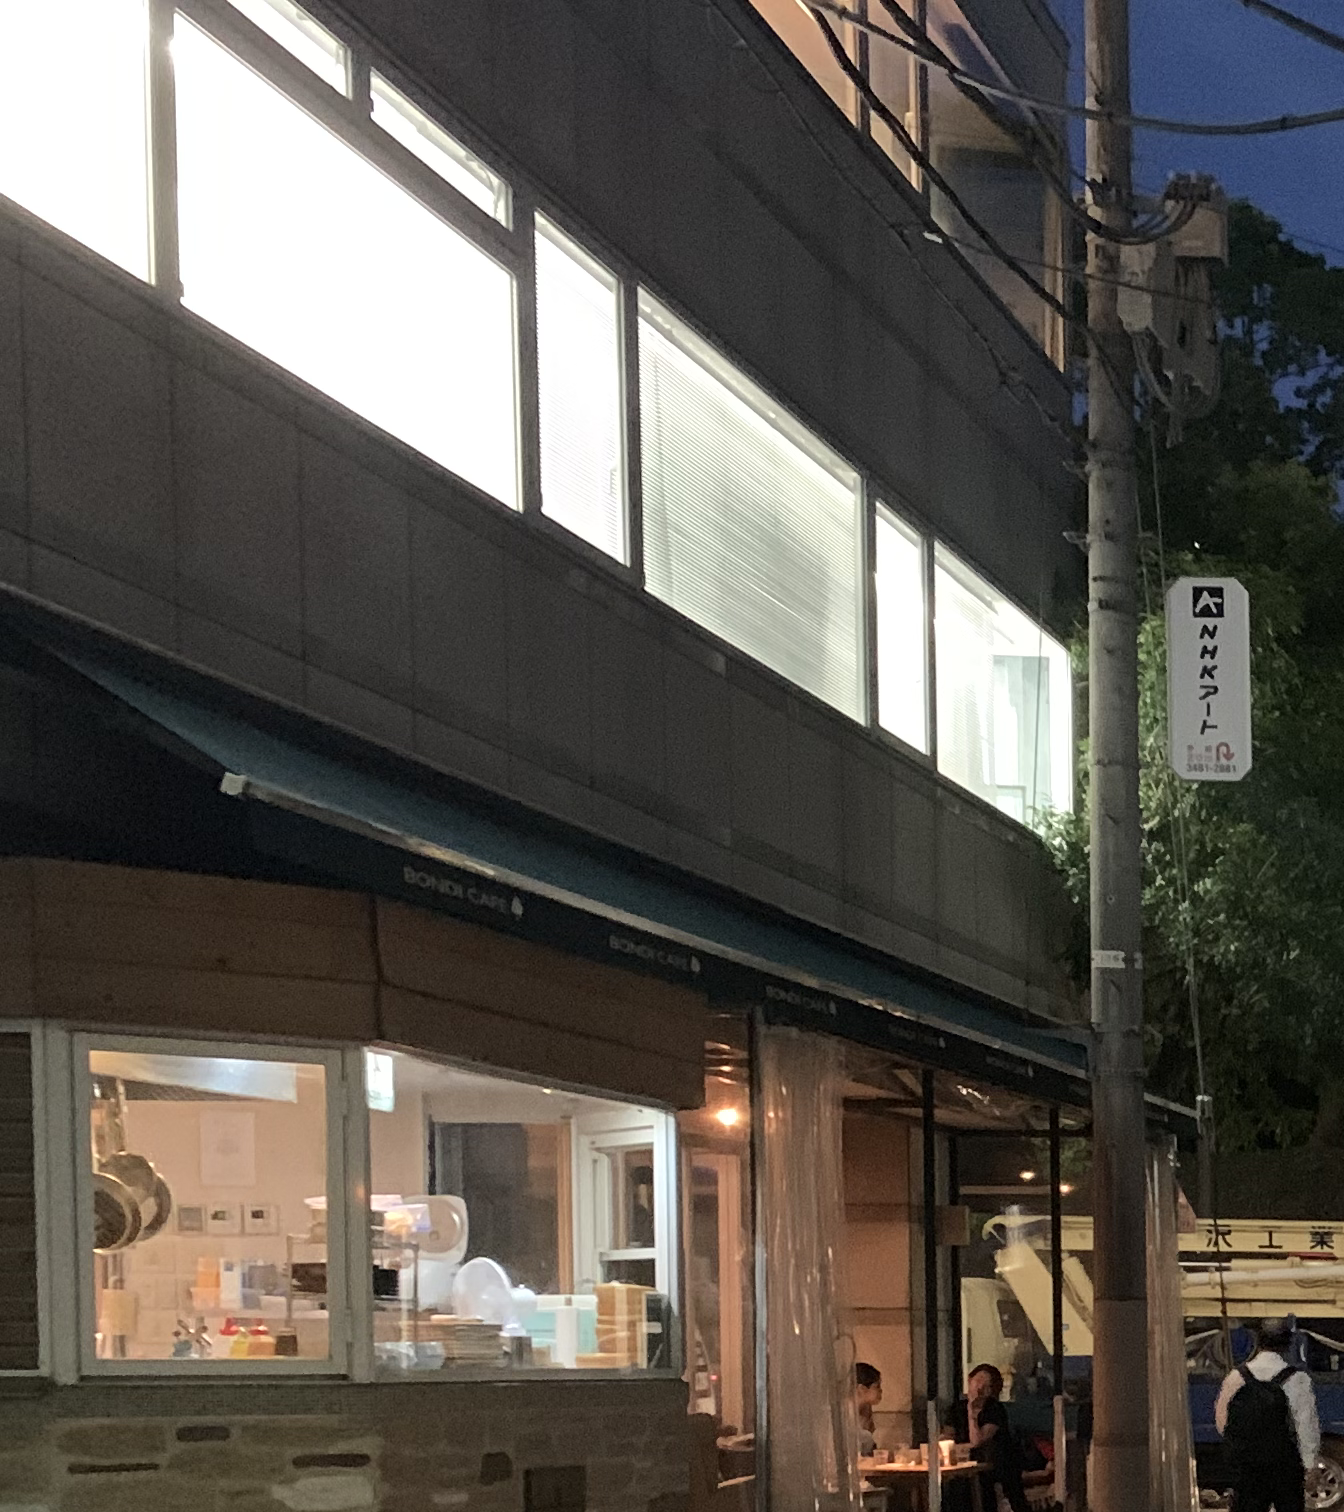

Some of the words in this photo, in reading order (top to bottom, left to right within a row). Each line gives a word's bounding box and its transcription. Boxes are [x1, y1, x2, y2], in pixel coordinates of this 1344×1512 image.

[1199, 623, 1219, 736] NHKアート
[403, 865, 464, 899] BONDI
